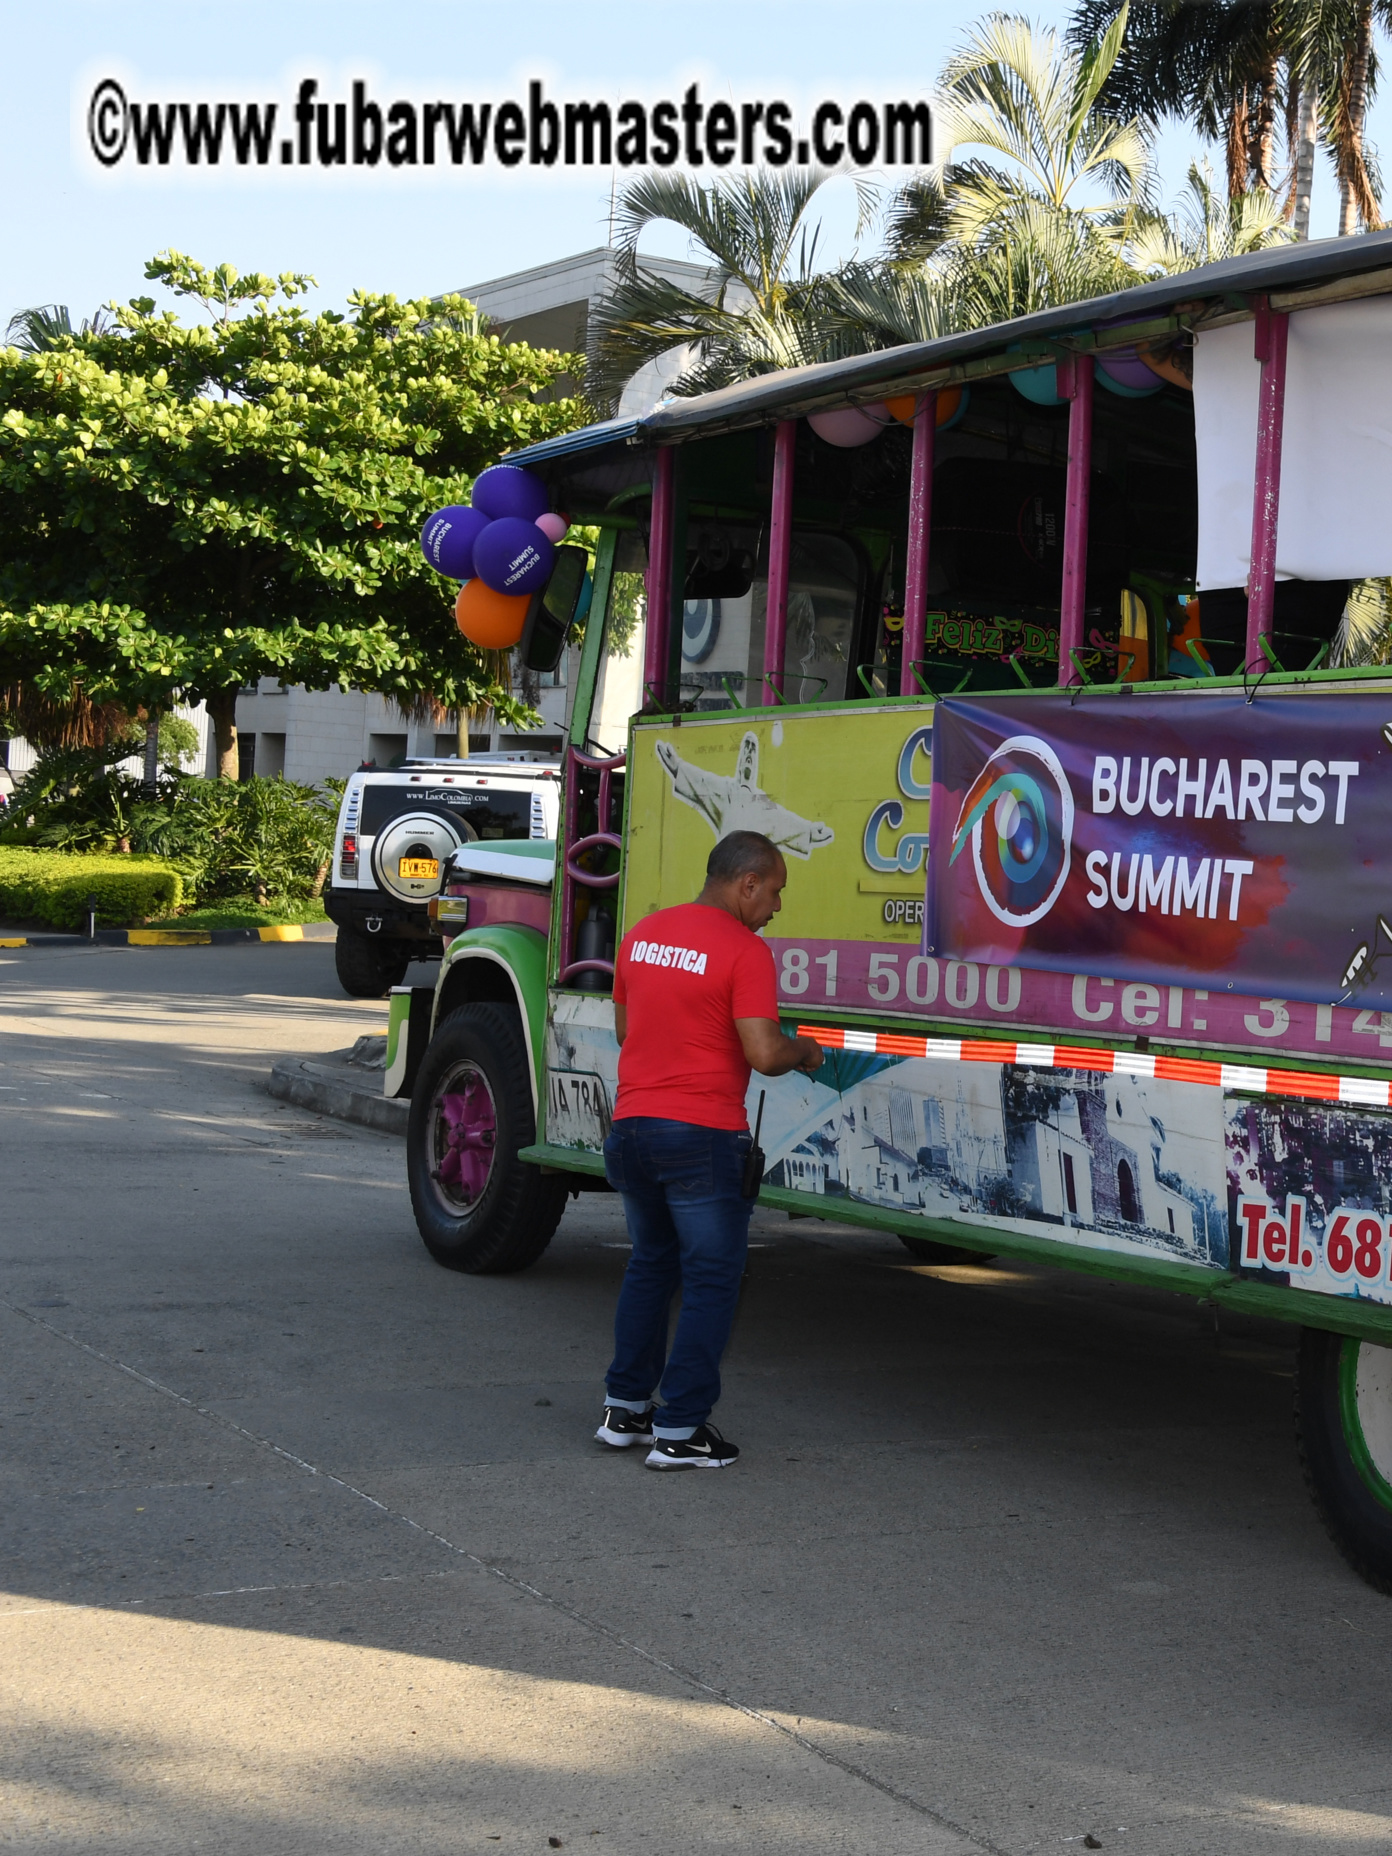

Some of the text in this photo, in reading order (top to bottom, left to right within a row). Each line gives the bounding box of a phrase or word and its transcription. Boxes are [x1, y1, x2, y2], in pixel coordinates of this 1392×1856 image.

[427, 518, 444, 546] SUMMIT
[433, 522, 452, 563] BUCHAREST
[504, 553, 540, 586] BUCHAREST
[508, 545, 534, 571] SUMMIT
[925, 611, 1060, 659] Feliz Di
[1092, 756, 1359, 825] BUCHAREST
[1085, 850, 1254, 921] SUMMIT
[884, 900, 924, 923] OPER
[630, 941, 707, 975] LOGISTICA
[775, 948, 839, 997] 81
[868, 953, 1021, 1013] 5000
[1242, 1203, 1312, 1268] Tel.
